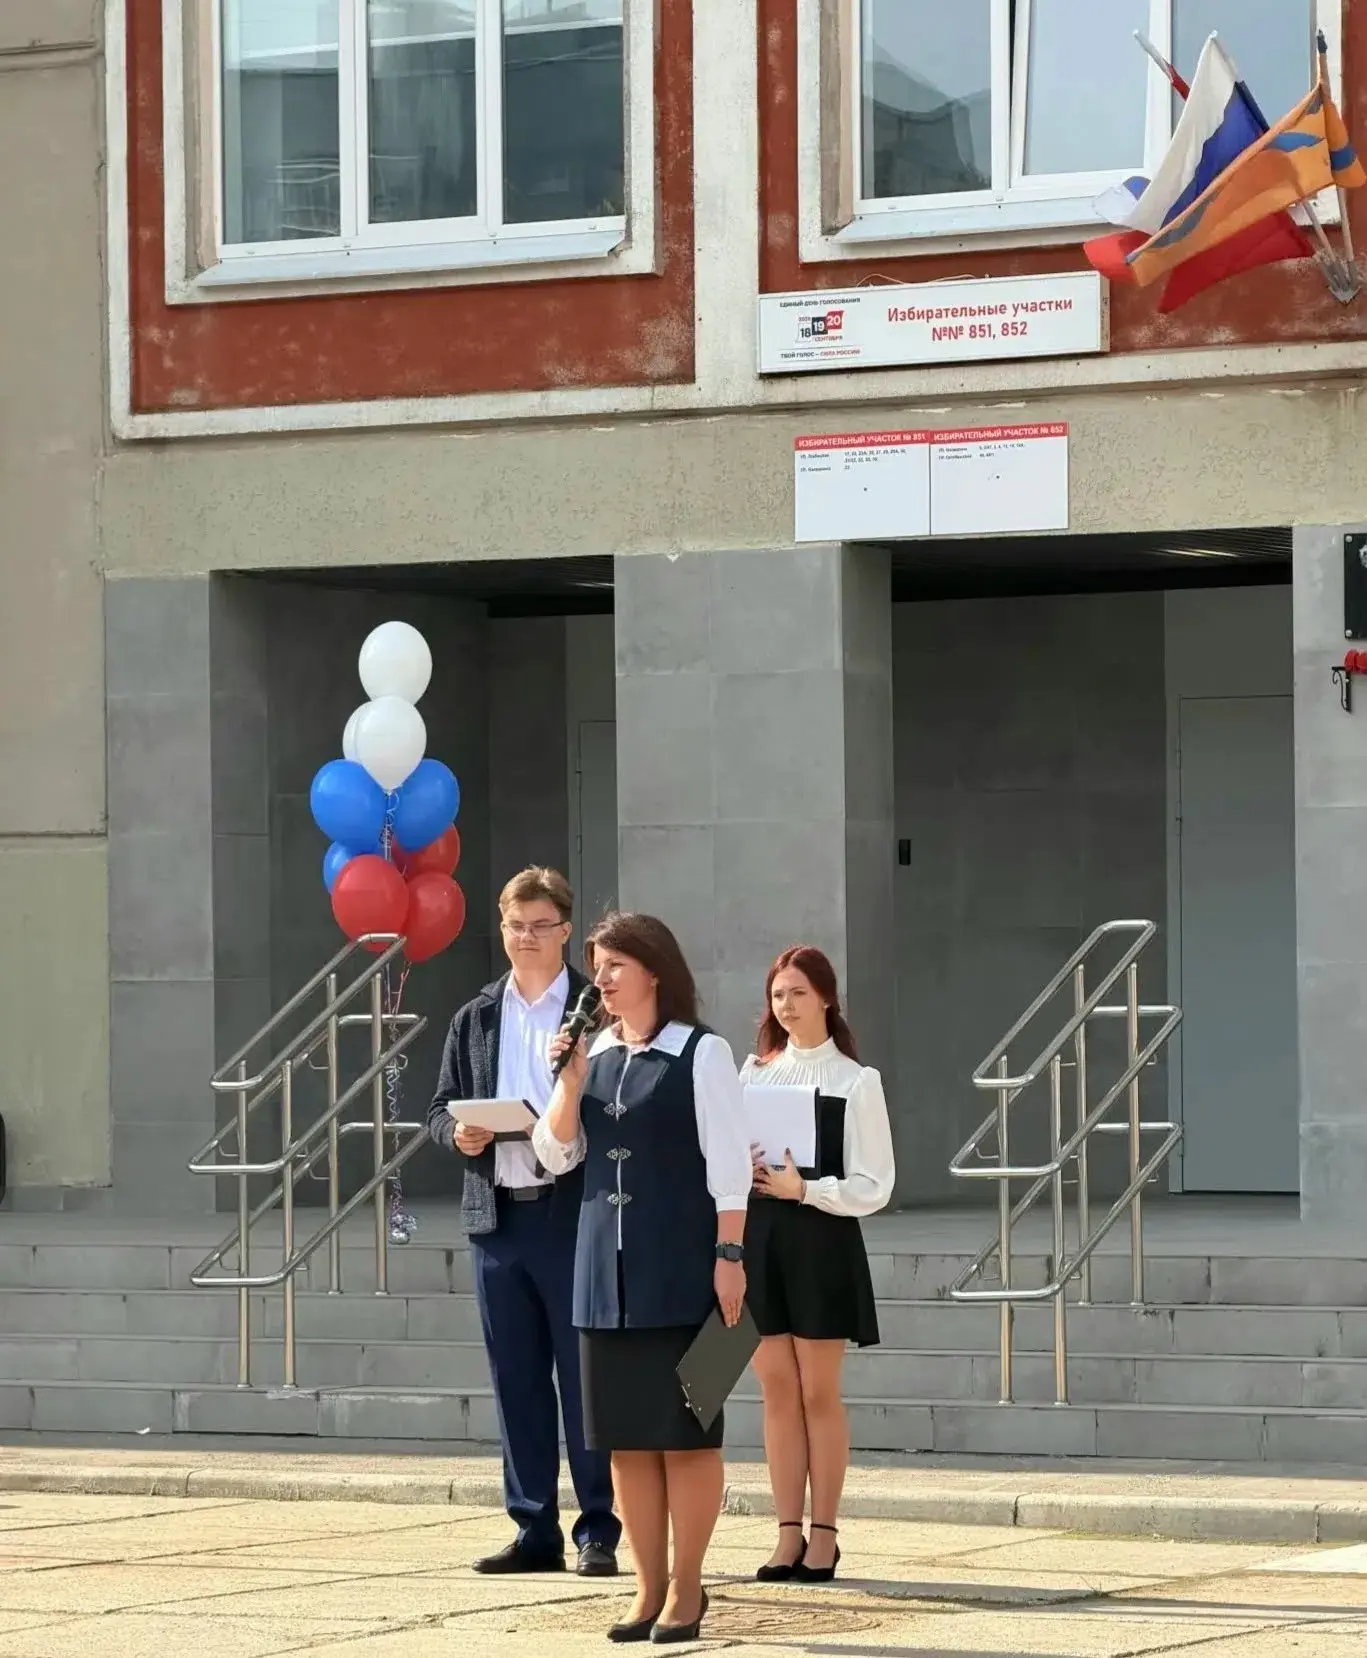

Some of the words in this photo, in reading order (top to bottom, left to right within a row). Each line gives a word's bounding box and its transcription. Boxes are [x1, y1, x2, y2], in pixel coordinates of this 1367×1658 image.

[779, 300, 804, 308] ЕДИНЫЙ
[819, 297, 861, 305] ГОЛОСОВАНИЯ
[888, 304, 1007, 323] Избирательные
[1012, 298, 1073, 317] участки
[827, 315, 841, 326] 20
[813, 321, 825, 332] 19
[932, 325, 964, 341] №№
[969, 323, 996, 339] 851,
[1001, 321, 1028, 336] 852
[800, 328, 812, 338] 18
[781, 351, 796, 359] ТВОЙ
[933, 428, 1002, 441] ИЗБИРАТЕЛЬНЫЙ
[1003, 427, 1039, 437] УЧАСТОК
[1050, 425, 1064, 434] 852
[798, 435, 866, 447] ИЗБИРАТЕЛЬНЫЙ
[867, 434, 901, 444] УЧАСТОК
[913, 433, 926, 441] 851
